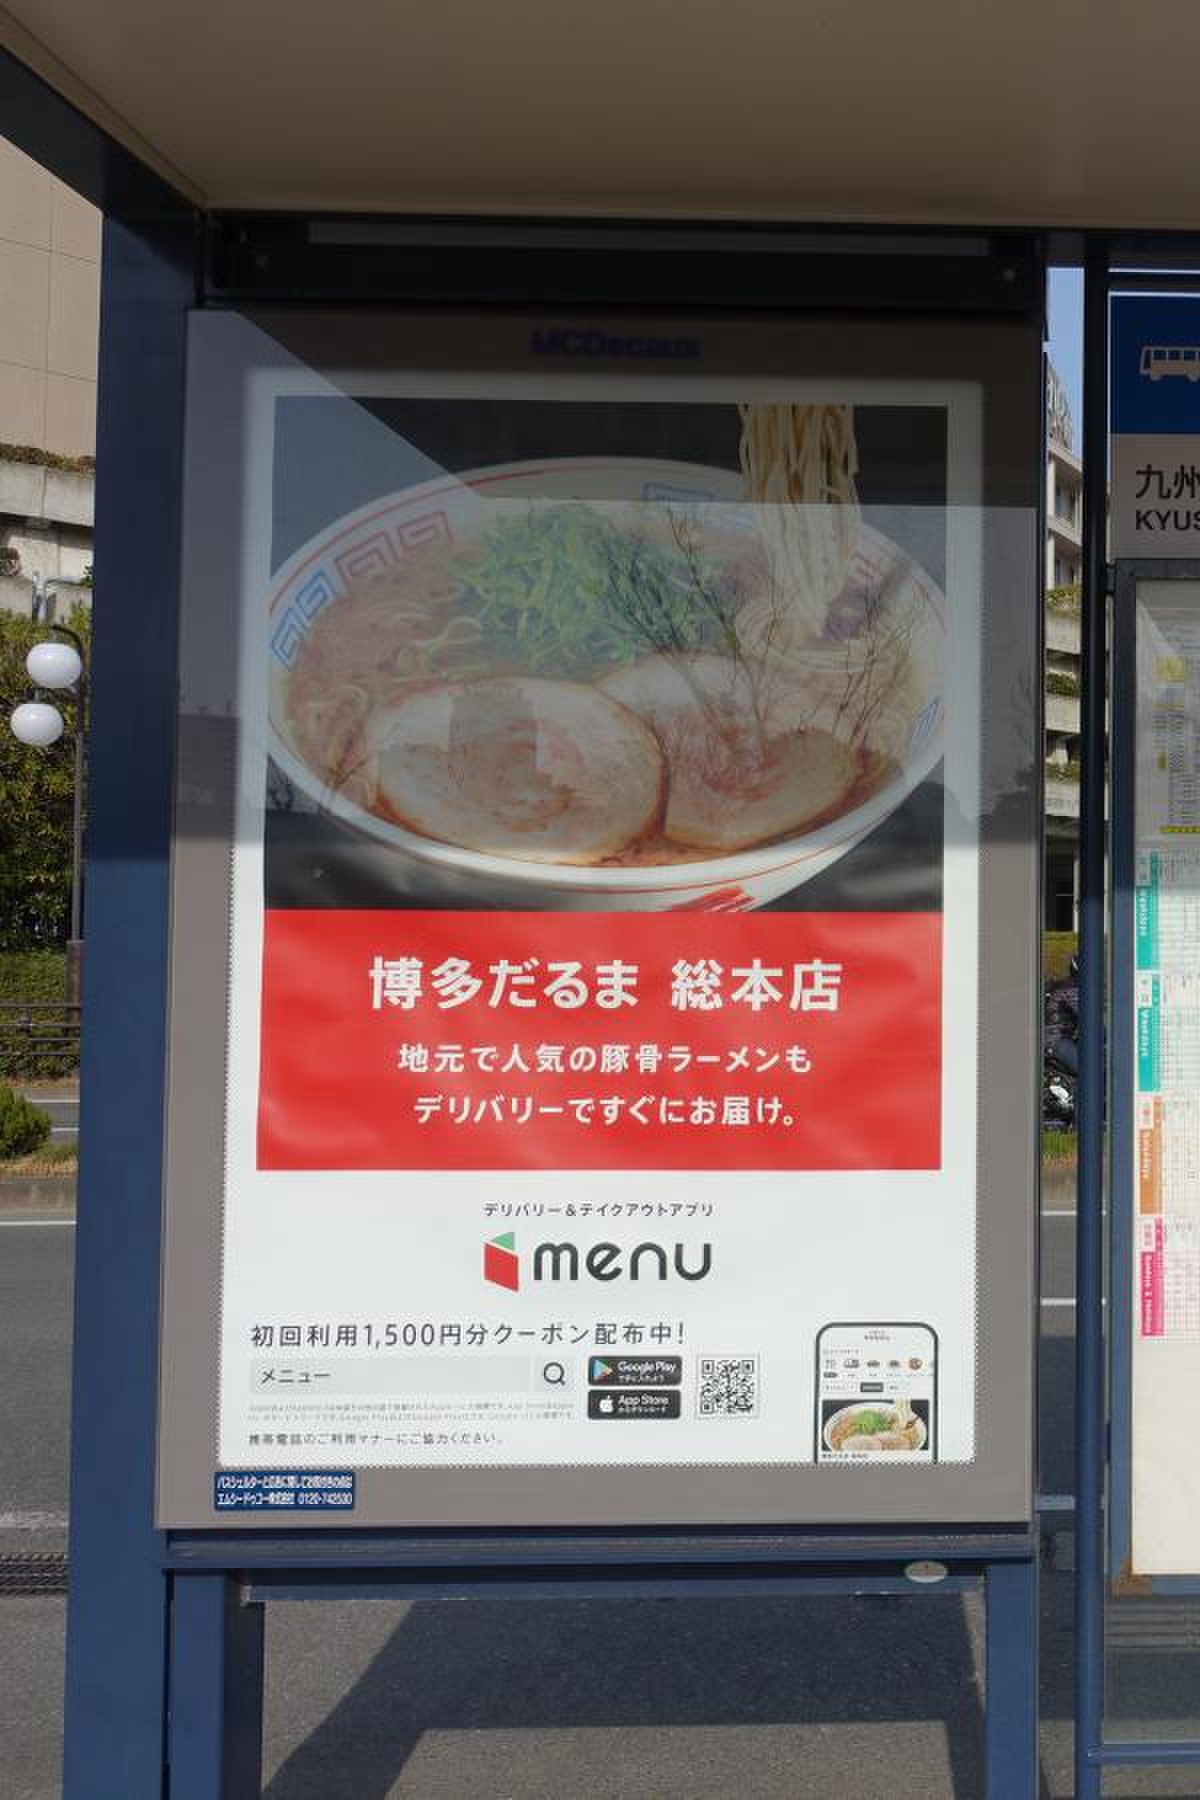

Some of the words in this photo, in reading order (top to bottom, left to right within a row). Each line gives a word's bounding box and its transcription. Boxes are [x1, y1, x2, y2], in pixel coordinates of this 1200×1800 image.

[532, 330, 701, 357] MCDecaux
[369, 956, 640, 1010] 博多だるま
[671, 958, 843, 1012] 総本店
[398, 1043, 812, 1074] 地元で人気の豚骨ラーメンも
[413, 1095, 797, 1126] デリバリーですぐにお届け。
[533, 1242, 712, 1281] menu
[260, 1367, 331, 1385] メニュー
[617, 1361, 655, 1375] Google
[656, 1361, 677, 1374] Play
[618, 1394, 640, 1407] App
[641, 1393, 669, 1405] Store
